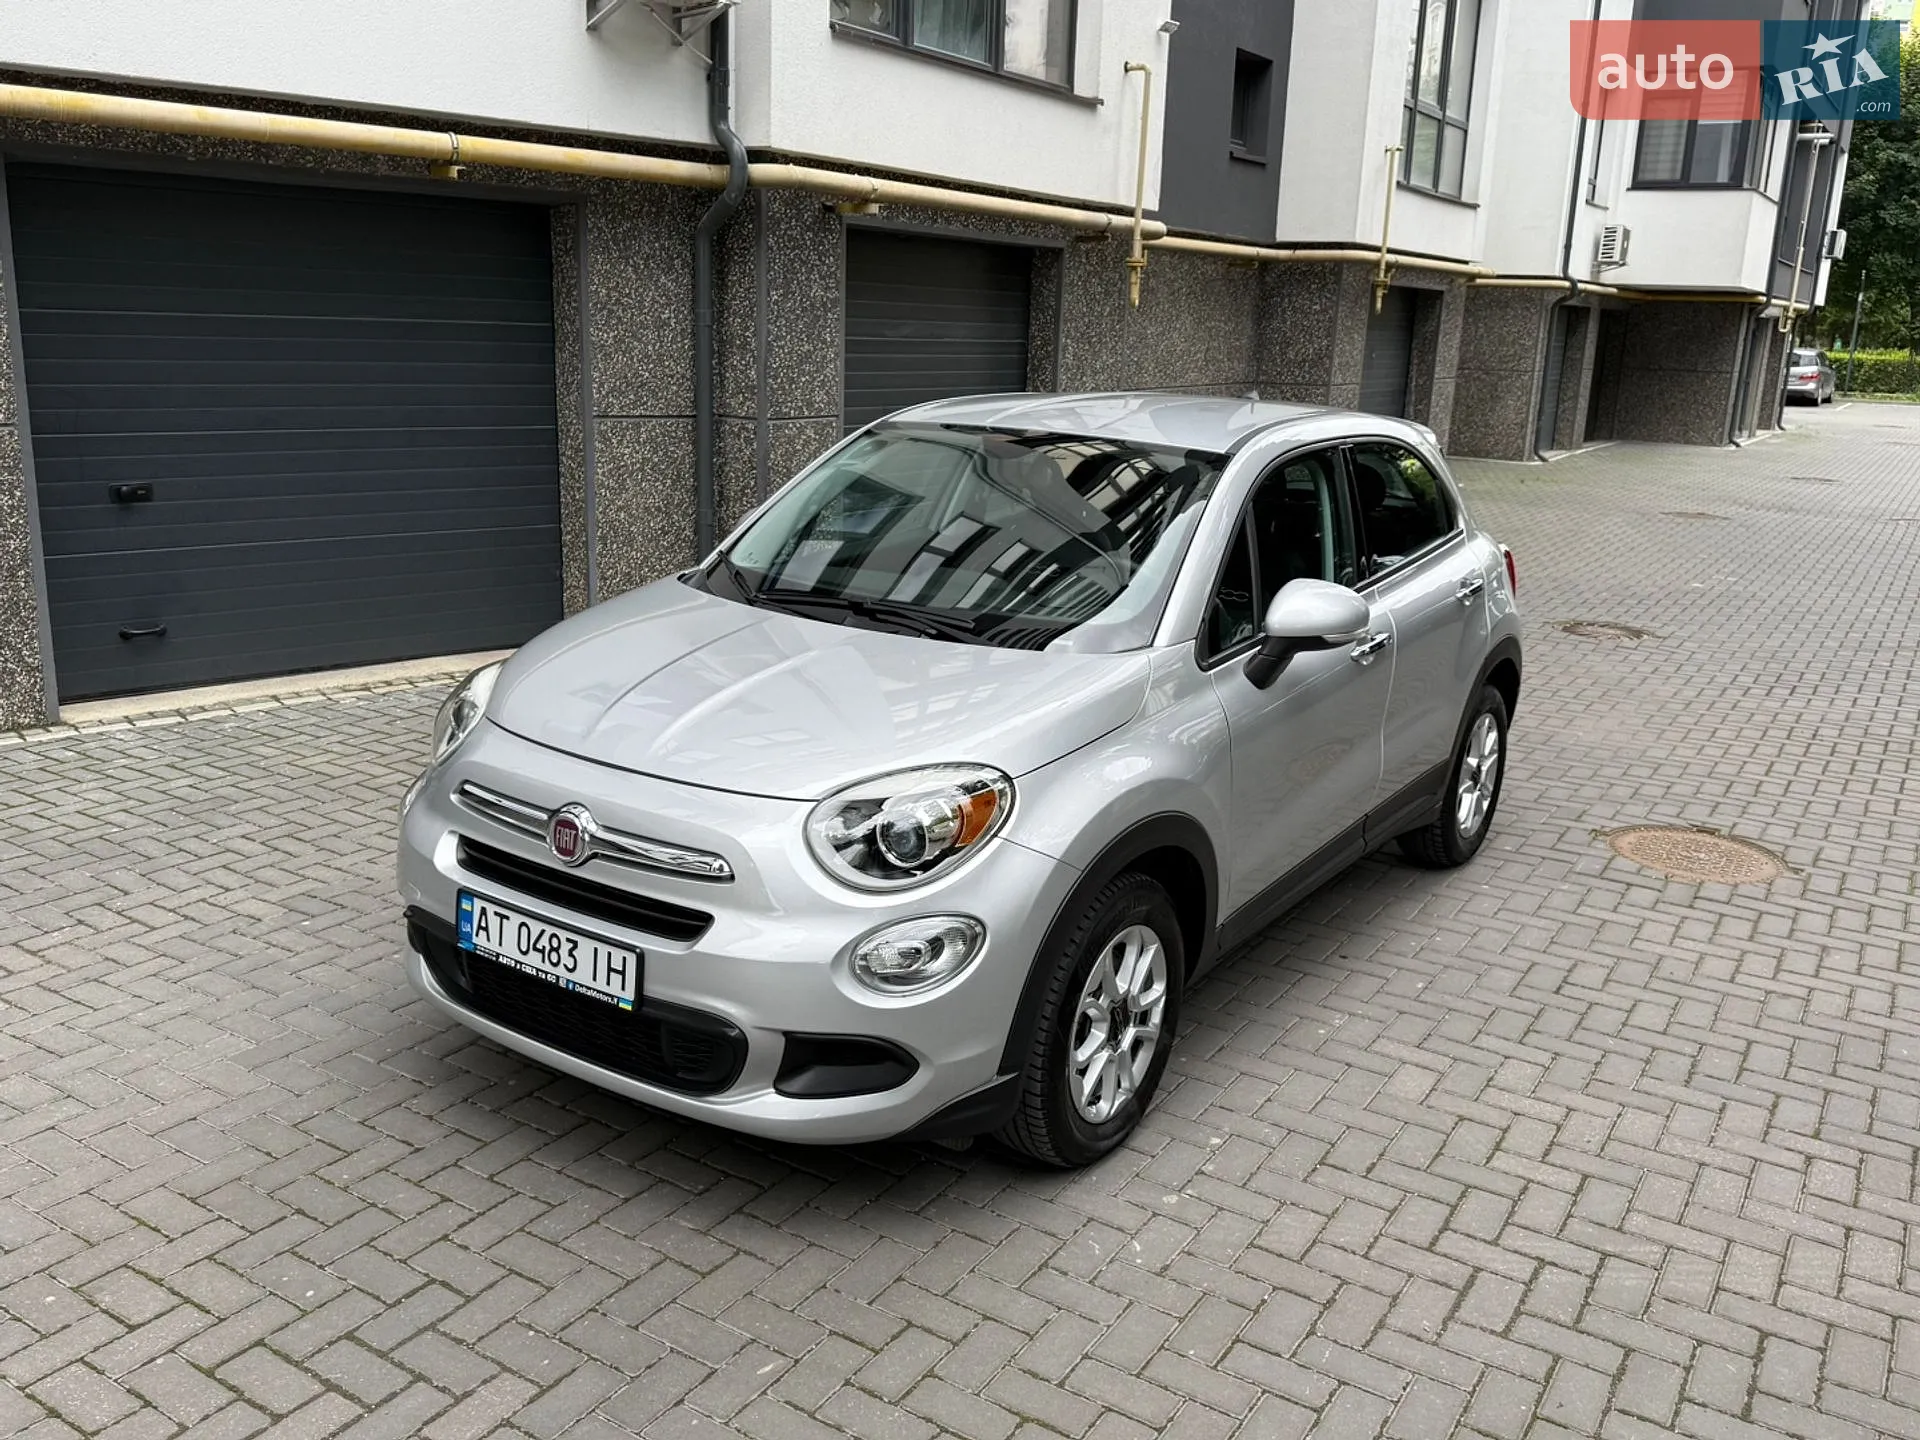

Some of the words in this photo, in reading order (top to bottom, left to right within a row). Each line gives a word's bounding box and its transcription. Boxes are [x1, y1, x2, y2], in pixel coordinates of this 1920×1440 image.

[556, 826, 577, 851] FIAT
[461, 919, 472, 934] UA
[475, 906, 510, 948] AT
[517, 921, 579, 974] 0483
[592, 946, 627, 992] IH
